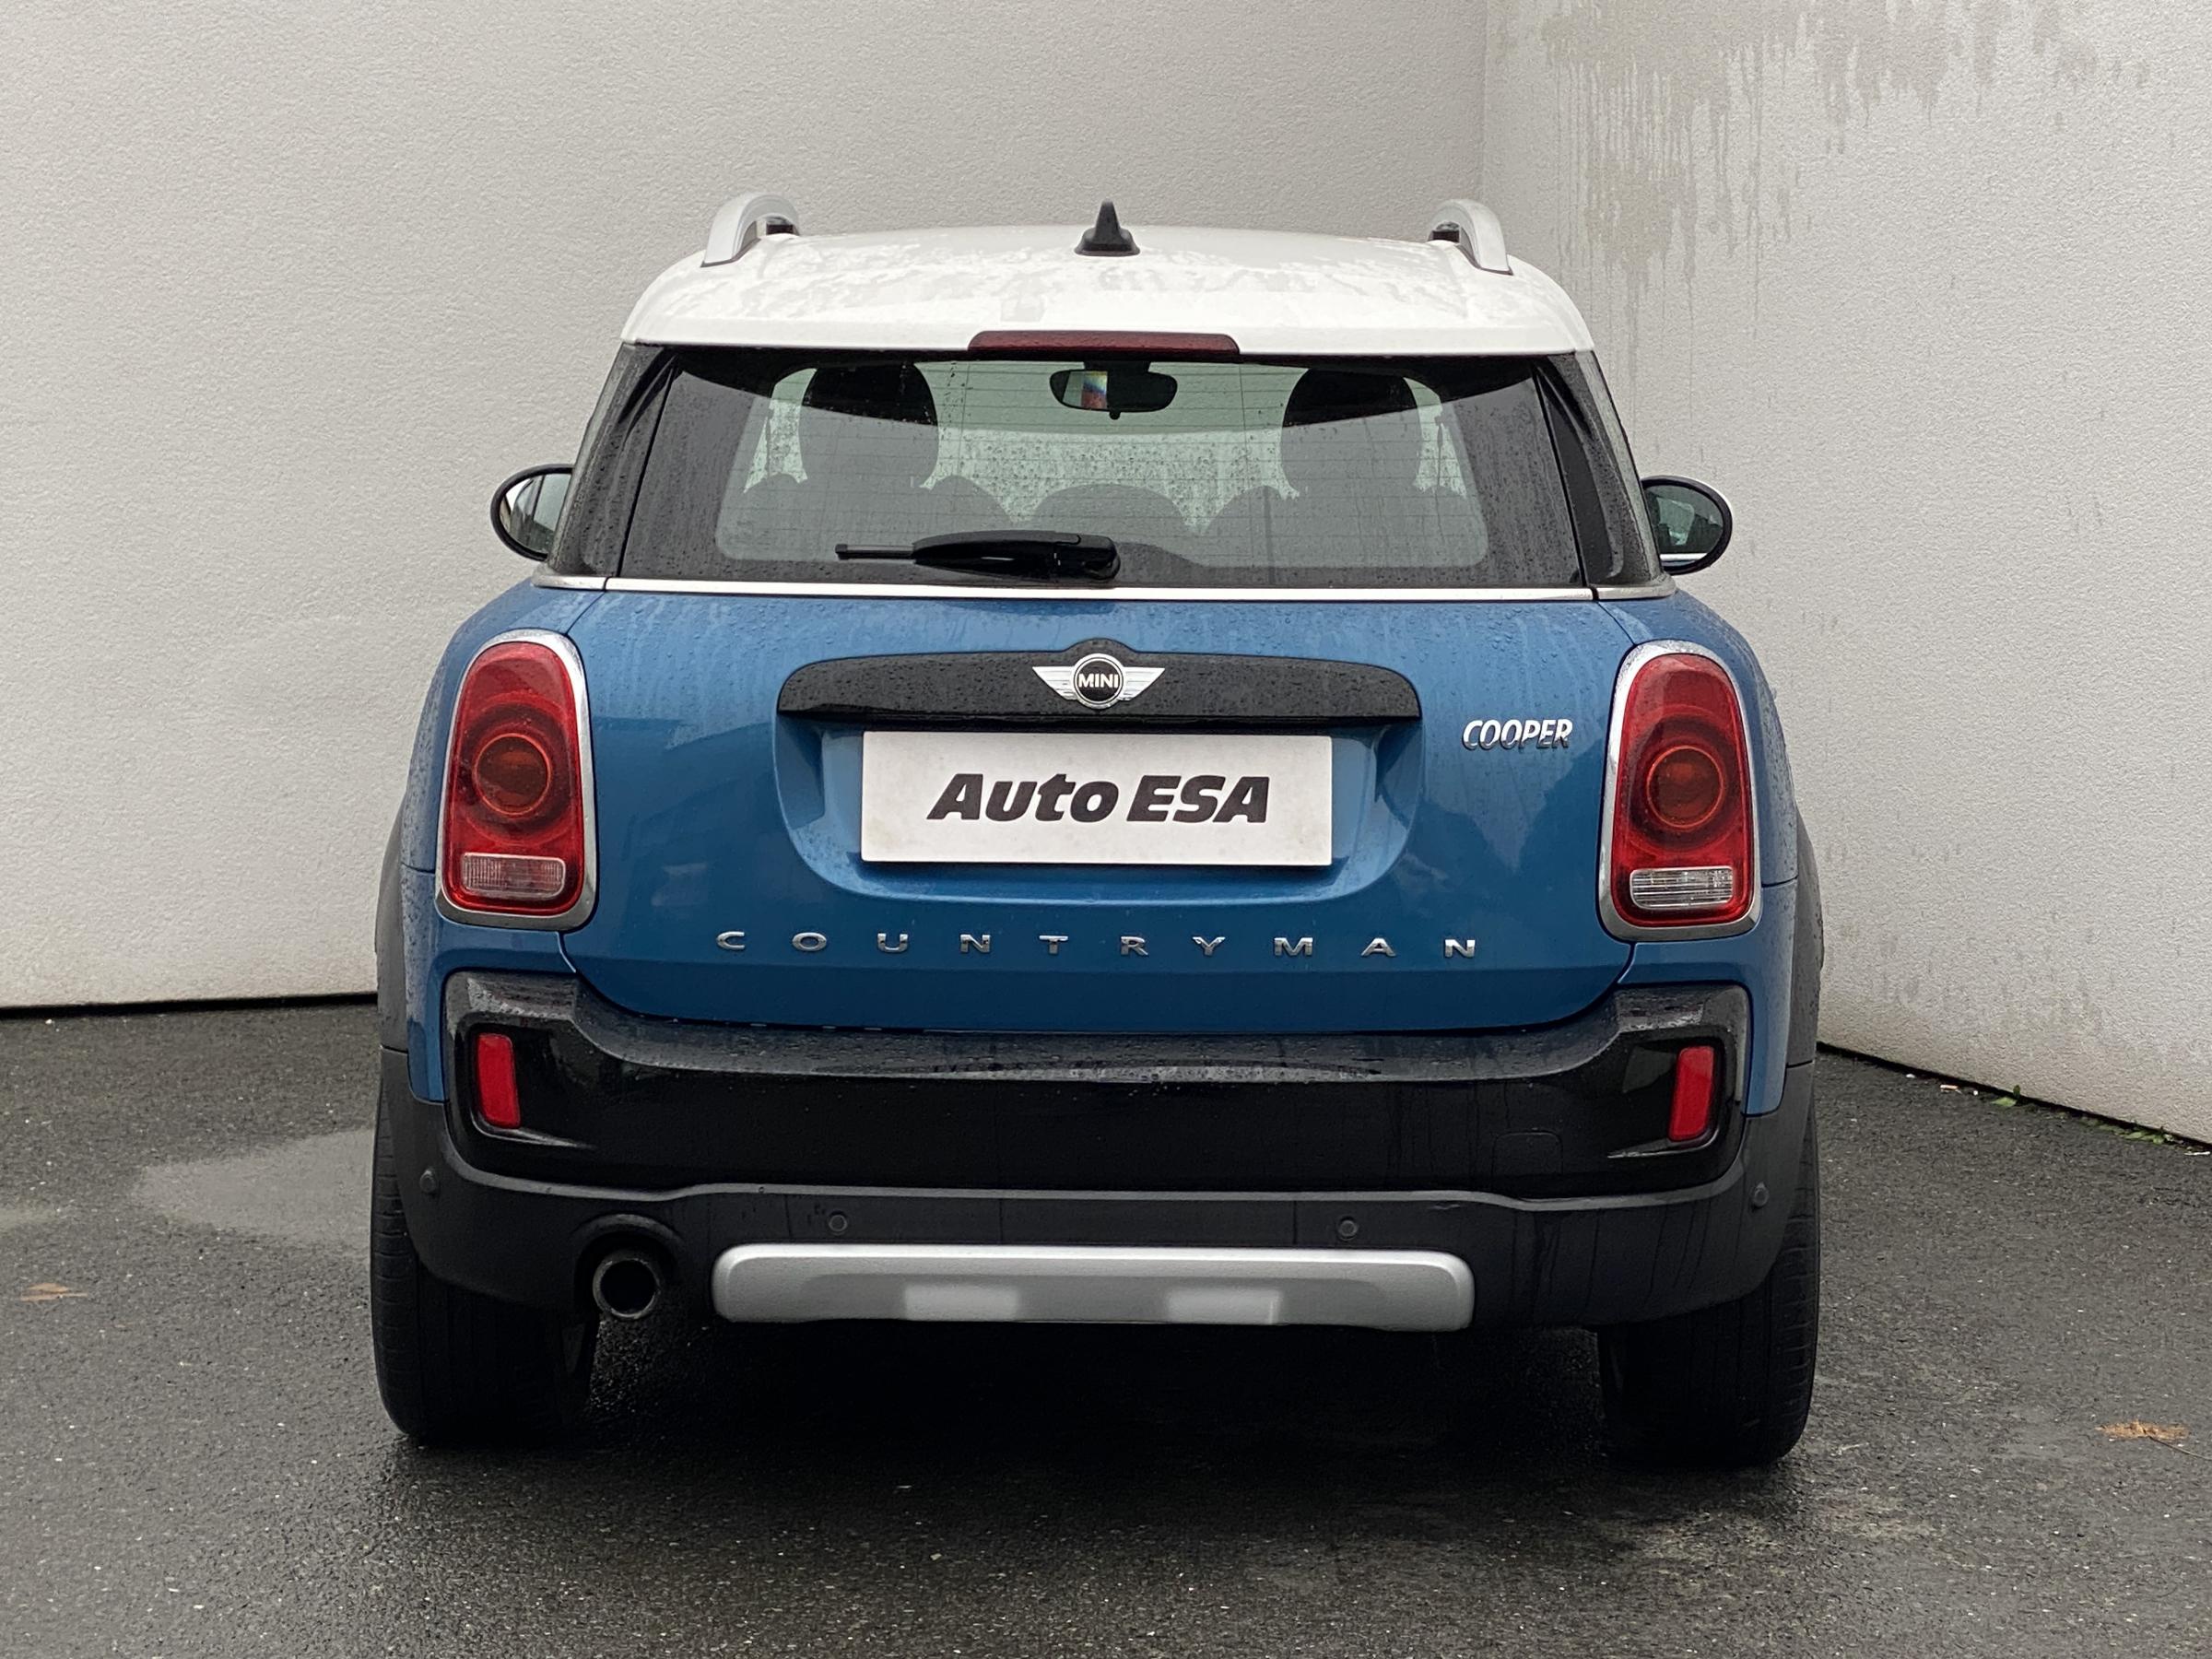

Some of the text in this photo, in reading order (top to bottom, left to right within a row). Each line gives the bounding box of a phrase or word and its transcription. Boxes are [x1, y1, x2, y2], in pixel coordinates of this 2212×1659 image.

[1078, 673, 1119, 688] MINI
[1462, 718, 1573, 750] COOPER
[926, 773, 1270, 823] Auto ESA
[715, 931, 1477, 958] COUNTRYMAN
